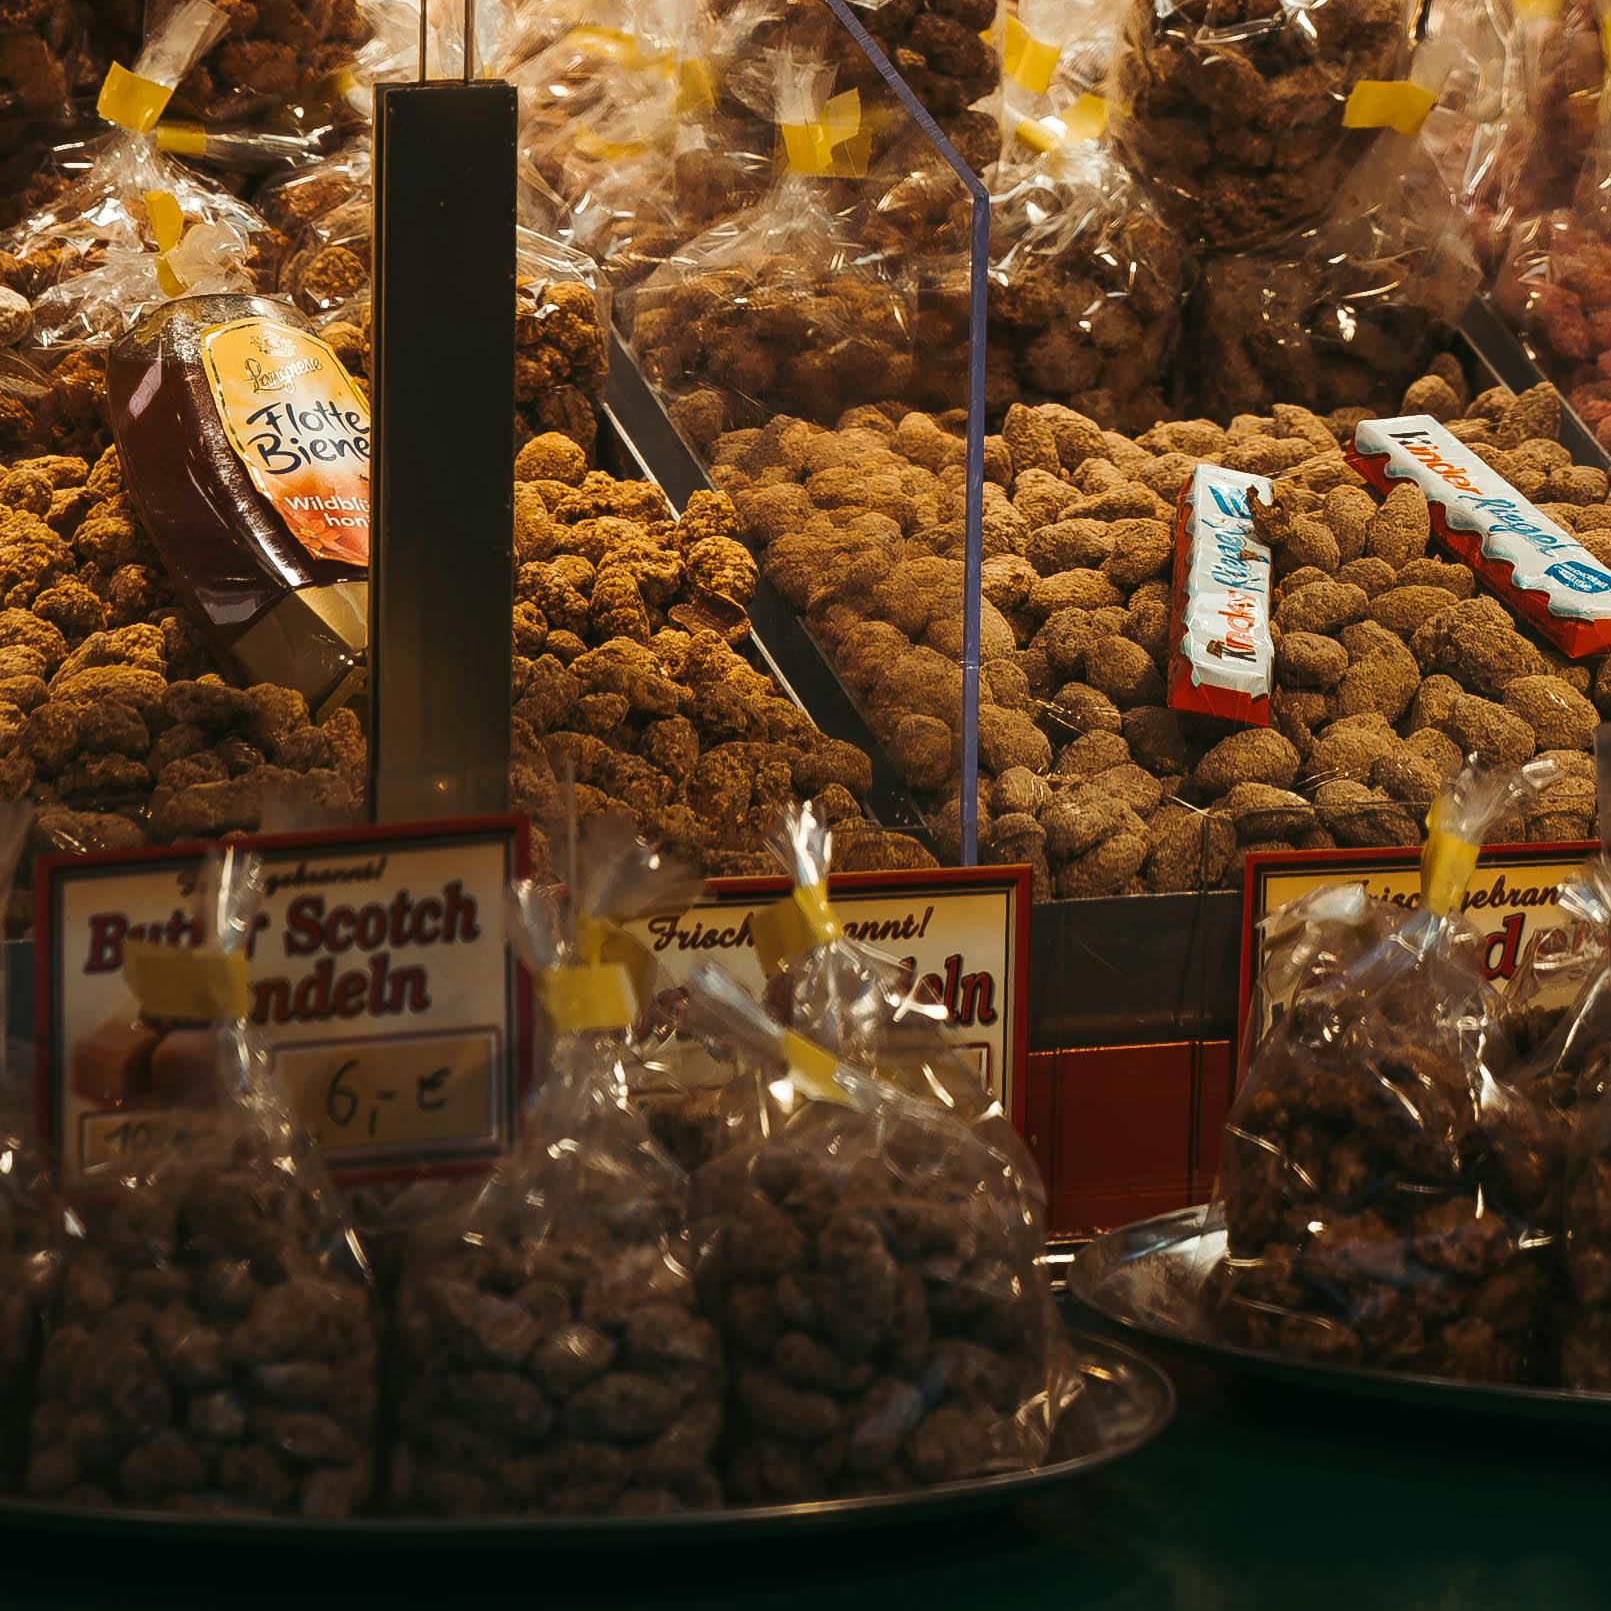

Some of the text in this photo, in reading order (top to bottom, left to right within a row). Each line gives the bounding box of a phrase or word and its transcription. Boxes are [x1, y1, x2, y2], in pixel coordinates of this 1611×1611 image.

[246, 400, 370, 437] Flotte
[247, 431, 371, 475] Biene
[323, 512, 370, 528] hon
[284, 880, 481, 957] Scotch
[647, 911, 756, 954] Frisch
[250, 954, 432, 1026] ndeln
